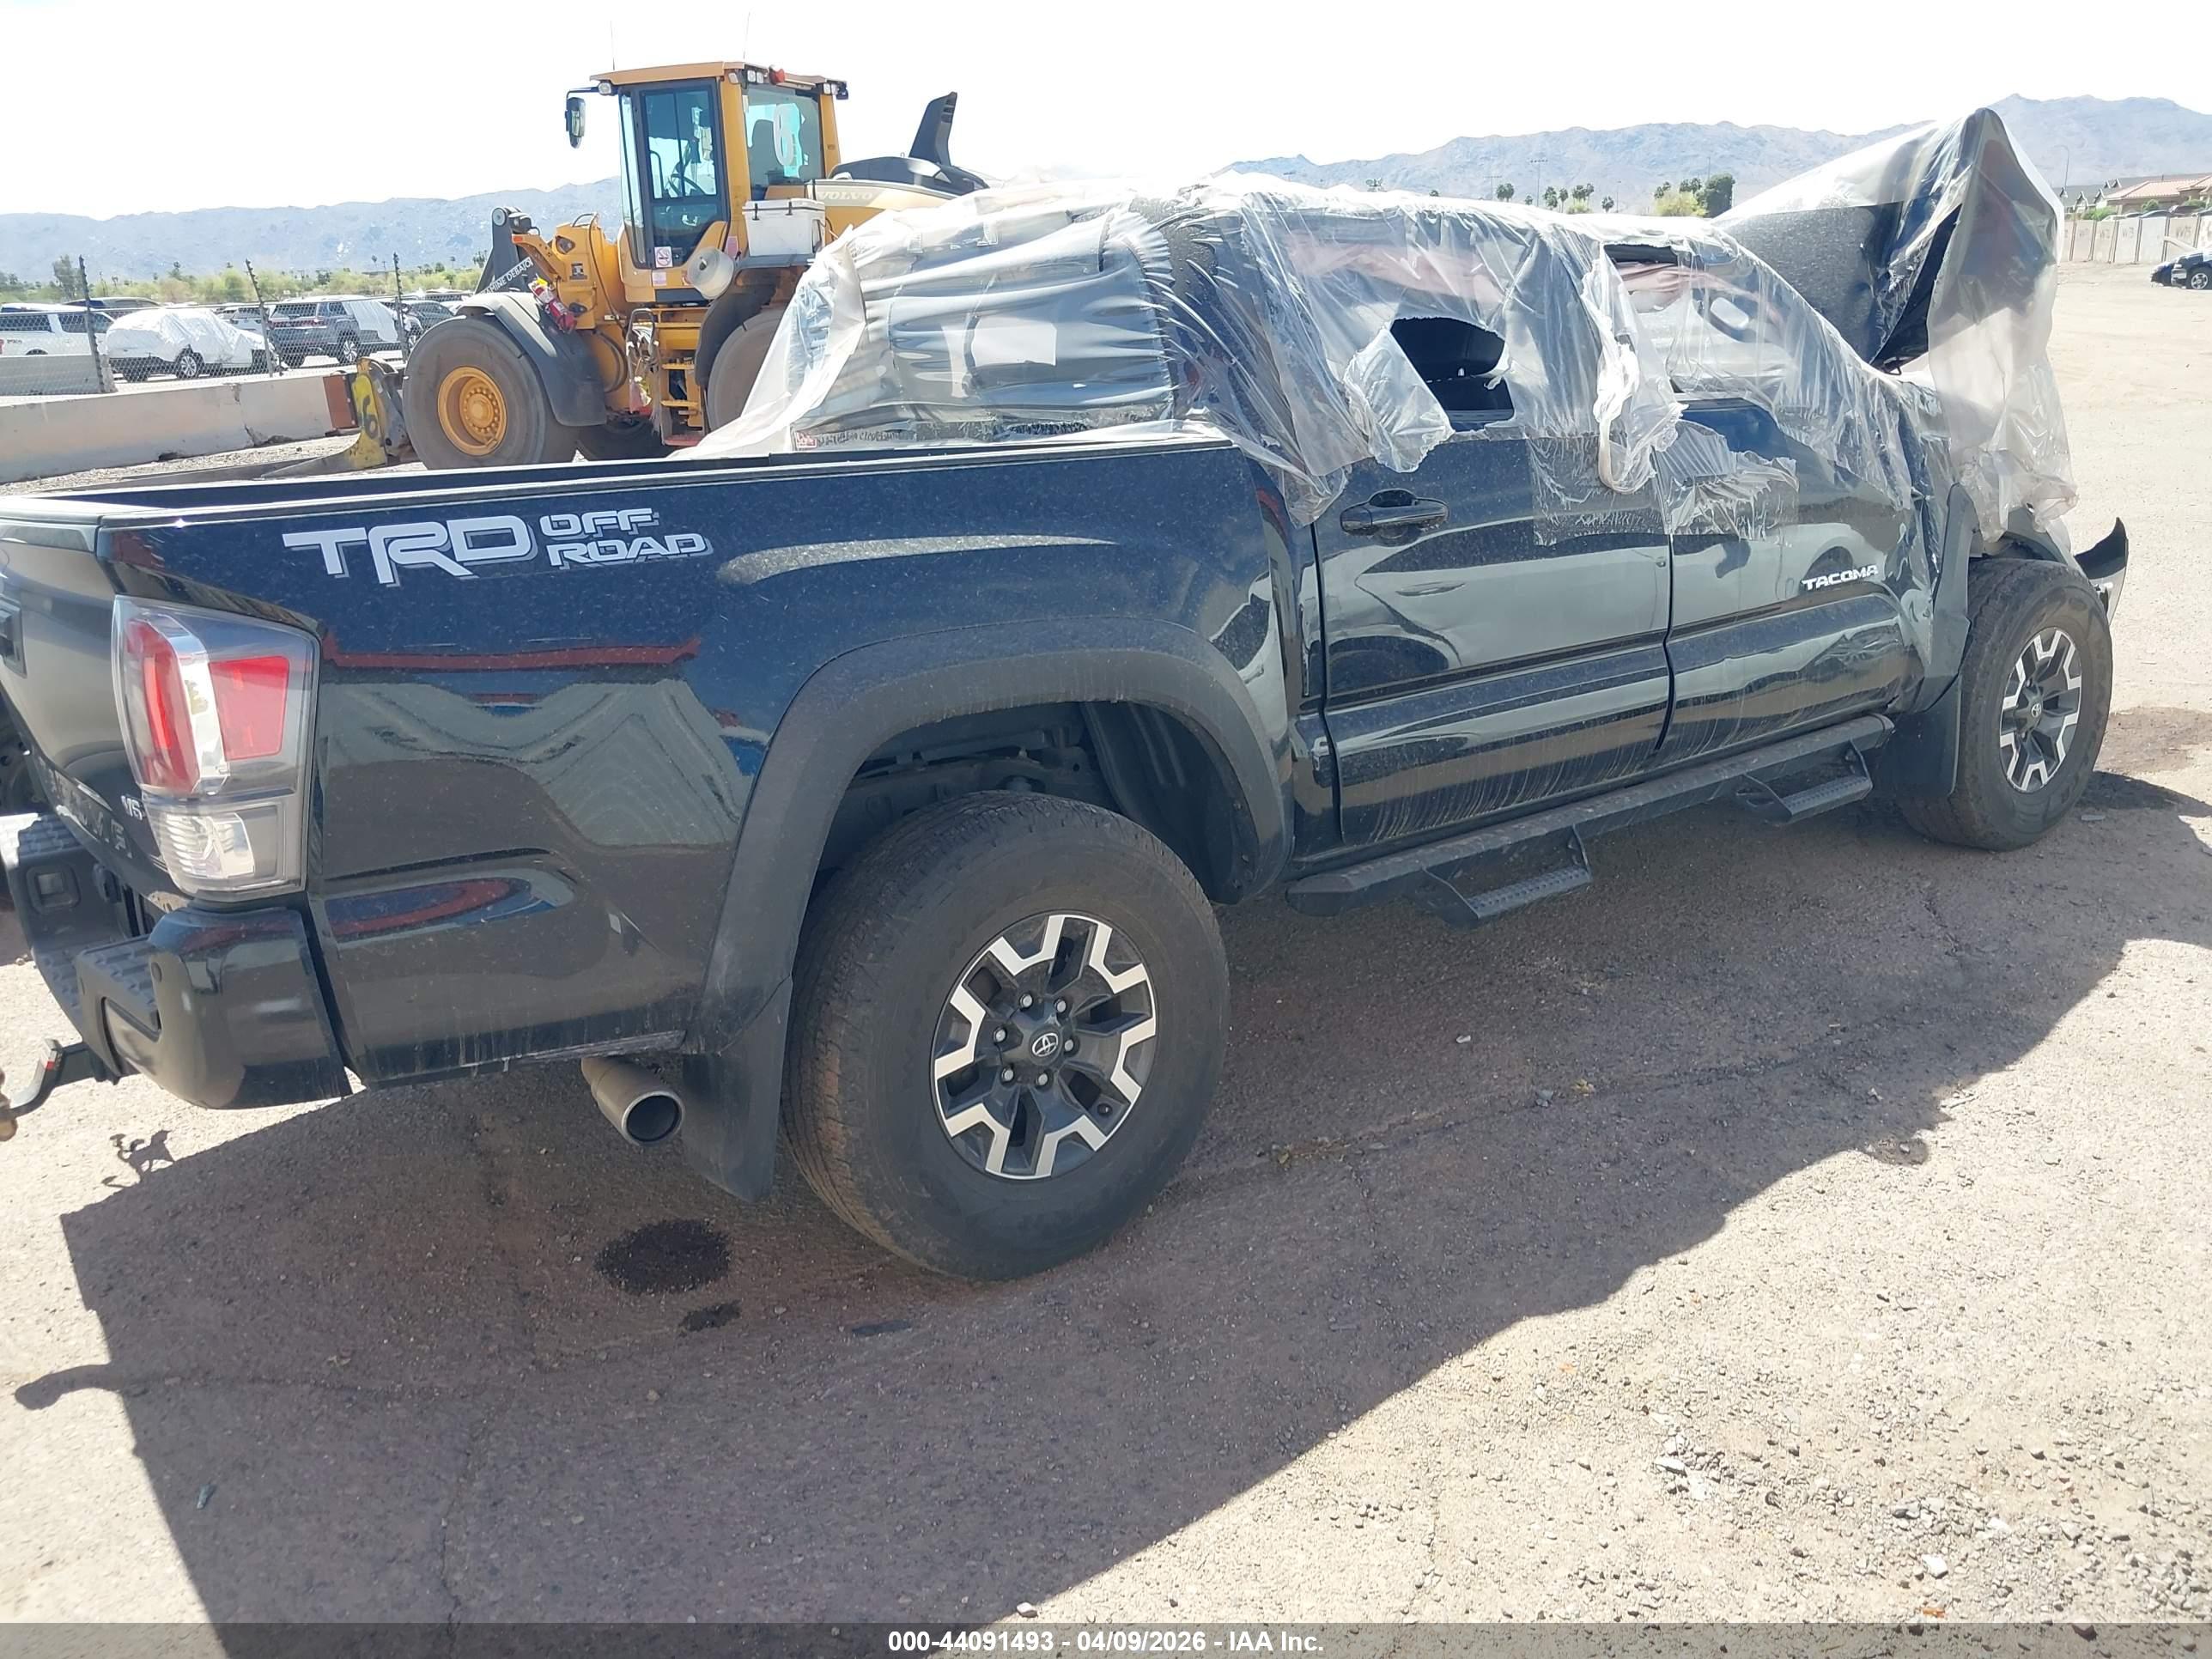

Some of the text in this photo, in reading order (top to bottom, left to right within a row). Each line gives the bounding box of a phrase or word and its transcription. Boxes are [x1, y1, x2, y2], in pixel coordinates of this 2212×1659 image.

[773, 103, 794, 167] 6
[817, 191, 874, 200] VOLVO
[506, 259, 532, 282] DEBAJO
[362, 395, 378, 440] 6
[282, 507, 659, 588] TRD OFF
[546, 532, 714, 570] ROAD
[1802, 564, 1879, 591] TACOMA
